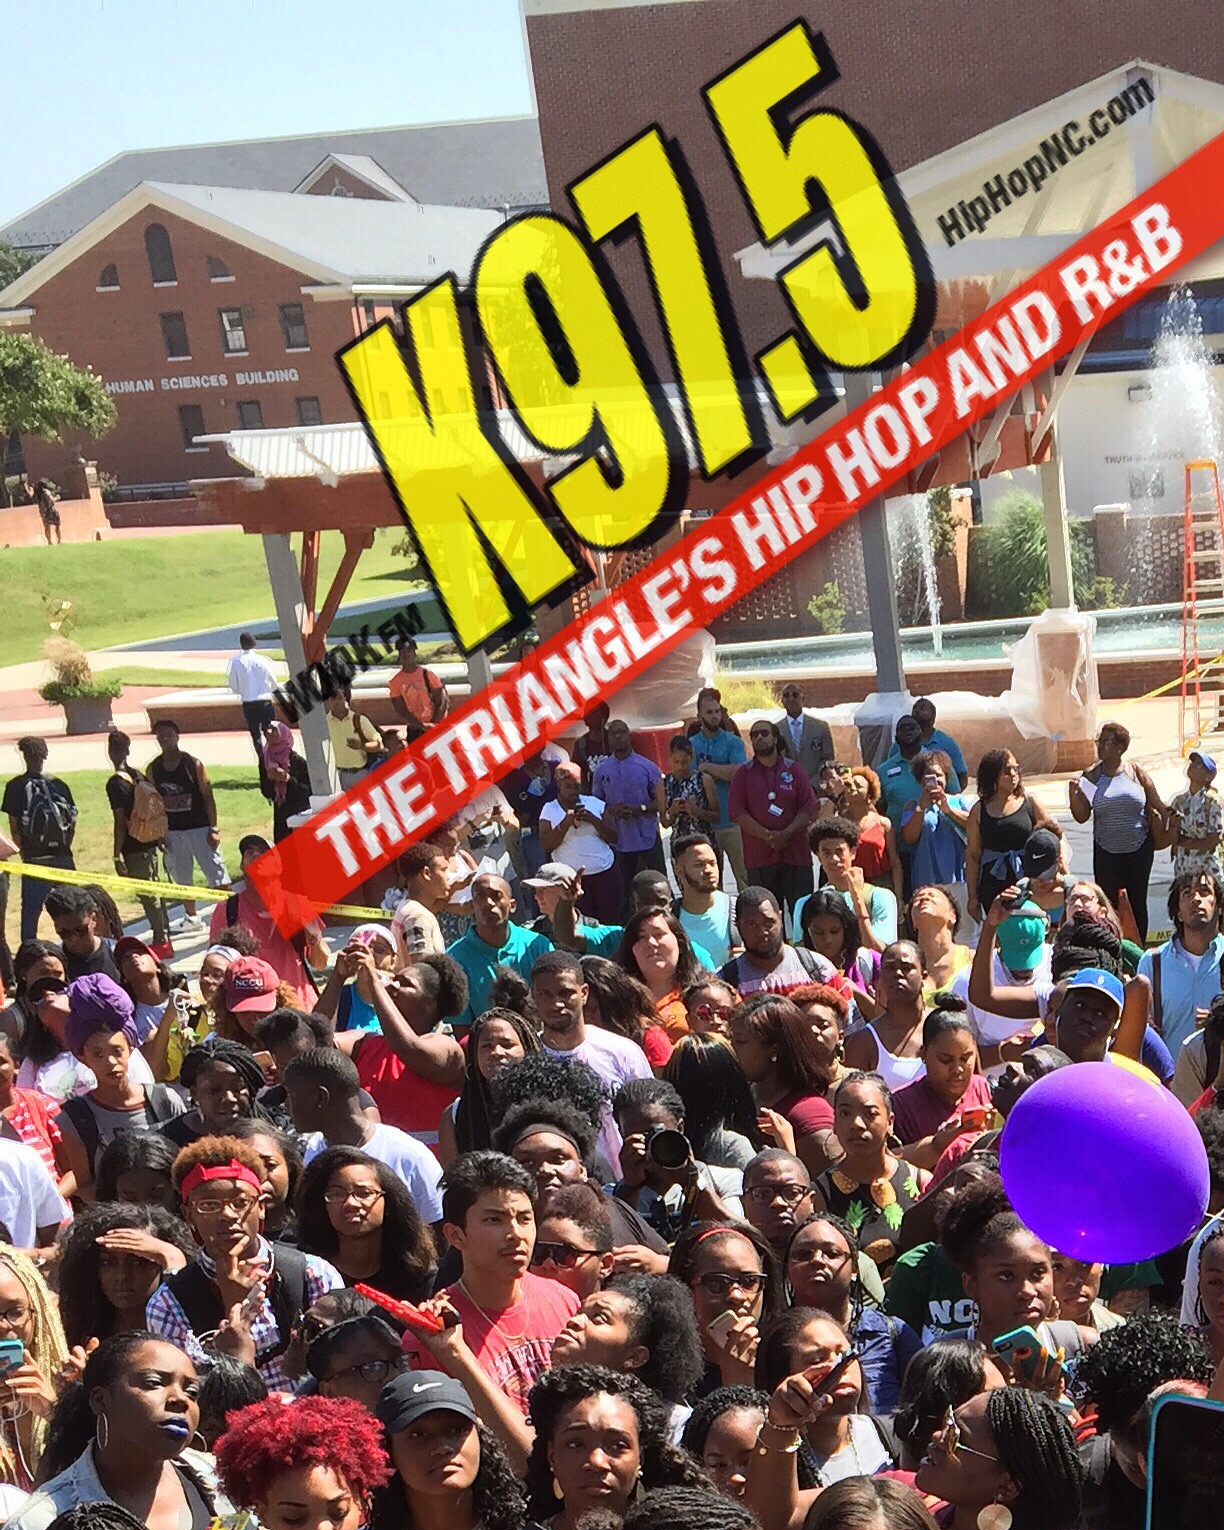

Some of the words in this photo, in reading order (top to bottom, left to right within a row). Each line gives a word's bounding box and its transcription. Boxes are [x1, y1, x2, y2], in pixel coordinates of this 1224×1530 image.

[105, 379, 155, 394] HUMAN
[161, 374, 229, 391] SCIENCES
[235, 368, 300, 386] BUILDING
